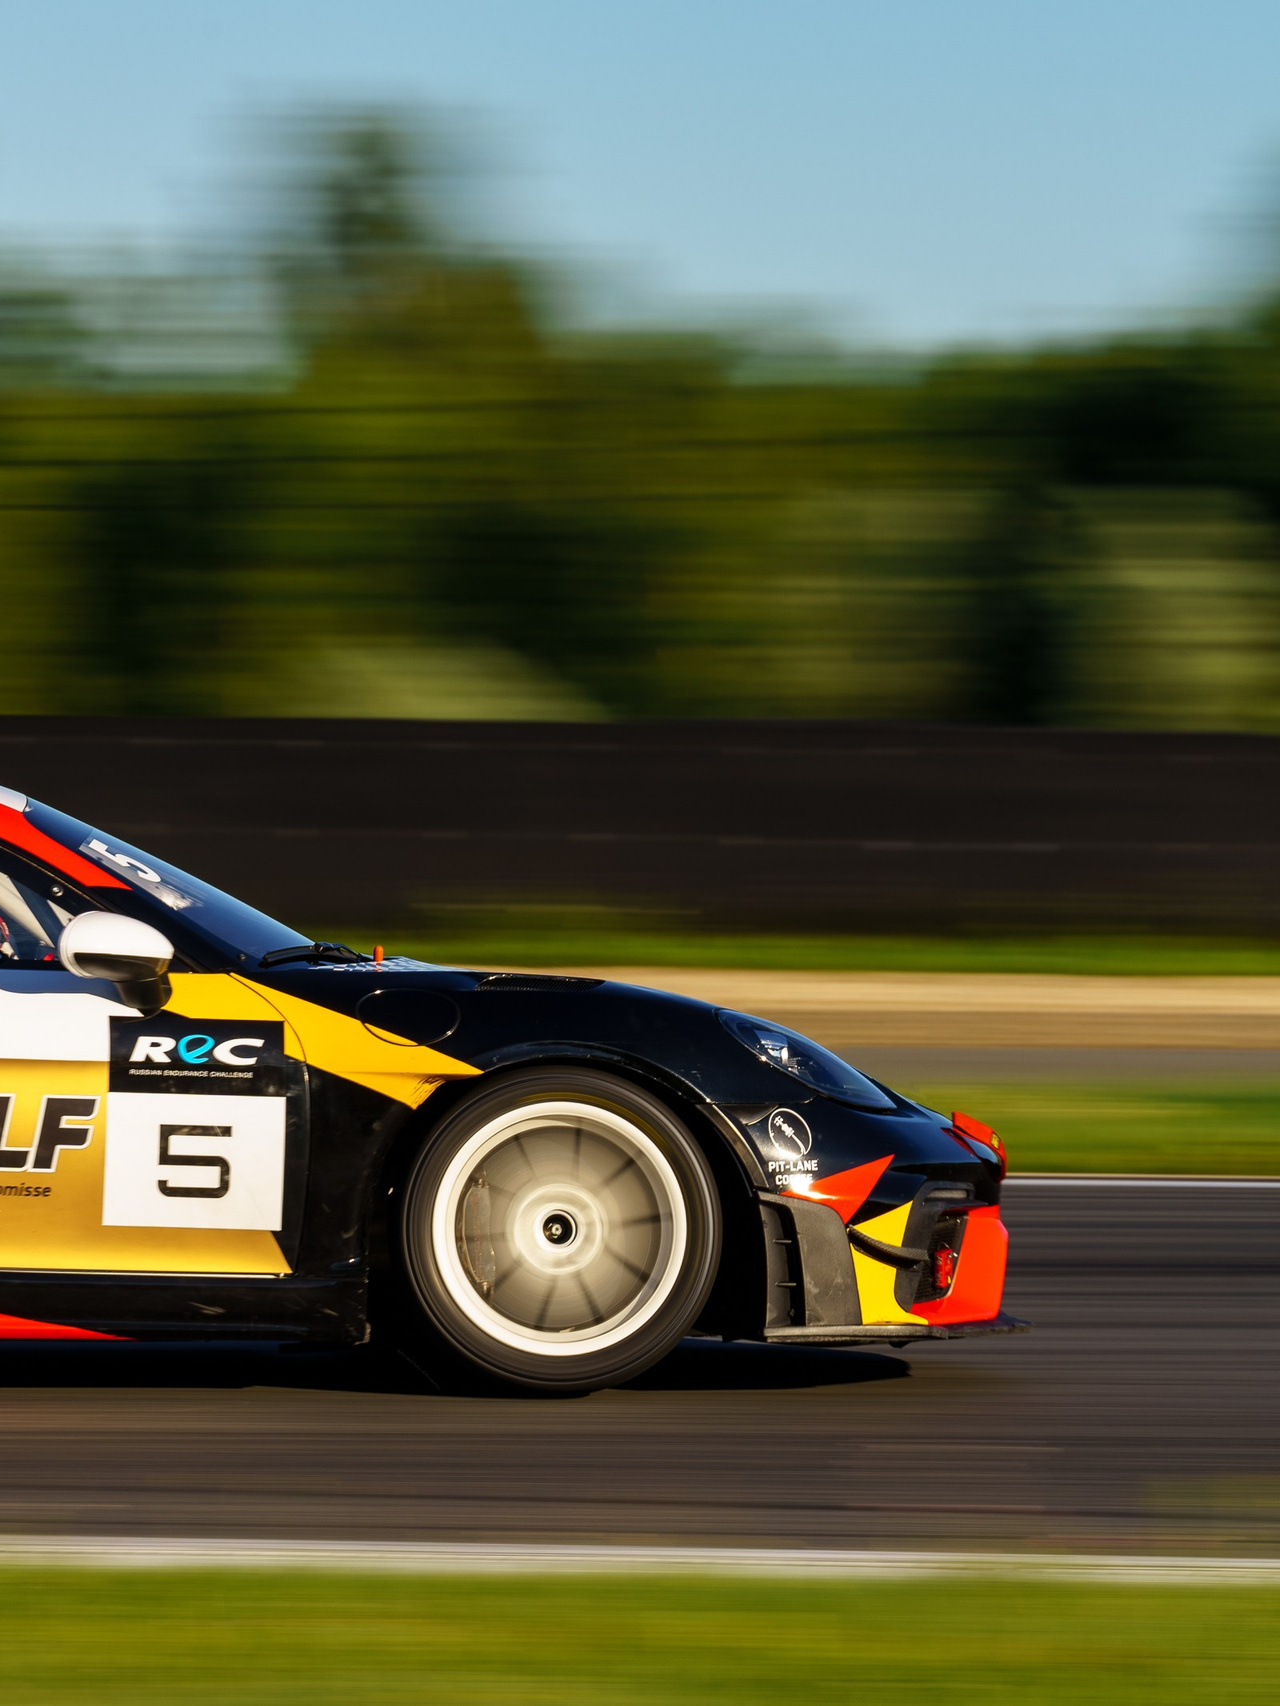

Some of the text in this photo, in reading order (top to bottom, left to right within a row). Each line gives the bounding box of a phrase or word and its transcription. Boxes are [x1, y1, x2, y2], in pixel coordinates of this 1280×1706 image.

[88, 839, 162, 883] 5
[128, 1068, 163, 1076] RUSSIAN
[209, 1071, 254, 1079] CHALLENGE
[157, 1123, 233, 1199] 5
[768, 1159, 819, 1173] PIT-LANE
